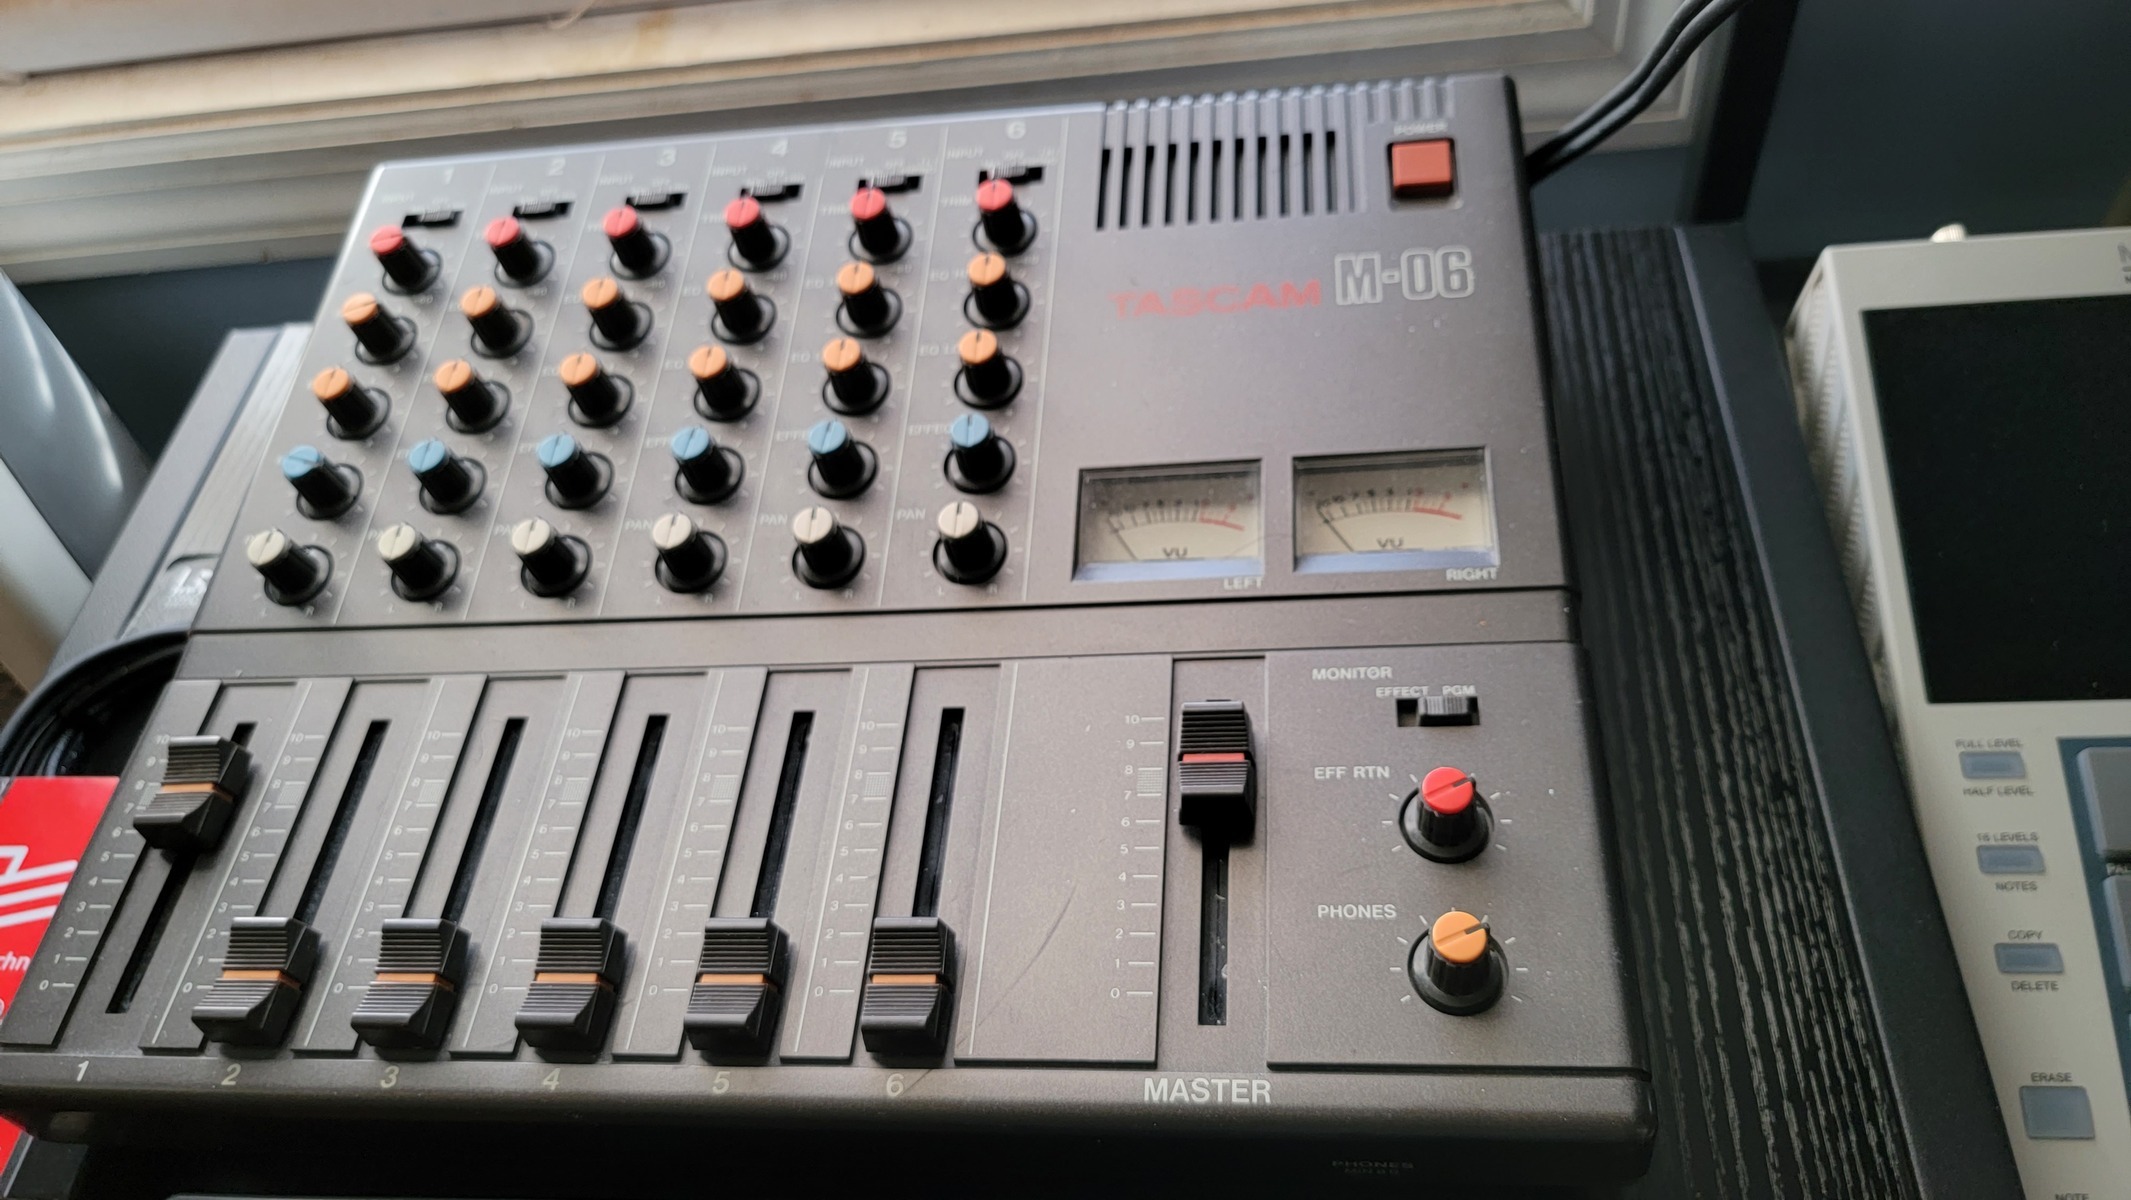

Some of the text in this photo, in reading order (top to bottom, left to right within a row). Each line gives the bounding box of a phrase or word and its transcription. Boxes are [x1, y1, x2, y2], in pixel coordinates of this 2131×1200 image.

[1007, 120, 1026, 140] 6
[1393, 121, 1447, 136] POWER
[888, 129, 907, 149] 5
[771, 138, 789, 157] 4
[656, 150, 676, 167] 3
[548, 157, 566, 176] 2
[1106, 244, 1475, 319] TASCAM M-06
[759, 514, 788, 526] PAN
[897, 508, 926, 521] PAN
[1376, 537, 1405, 549] VU
[1162, 546, 1189, 559] VU
[1446, 567, 1499, 582] RIGHT
[1223, 576, 1264, 591] LEFT
[1312, 666, 1393, 681] MONITOR
[1375, 686, 1429, 698] EFFECT
[1442, 685, 1476, 696] PGM
[1124, 714, 1140, 725] 10
[1126, 738, 1135, 749] 9
[1987, 738, 2023, 748] LEVEL
[1124, 764, 1134, 775] 8
[1314, 766, 1390, 780] EFF RTN
[1124, 790, 1132, 801] 7
[1963, 786, 2034, 796] HALF LEVEL
[690, 821, 699, 833] 6
[844, 819, 854, 830] 6
[1121, 816, 1131, 828] 6
[112, 826, 123, 838] 6
[251, 825, 262, 837] 6
[394, 825, 404, 836] 6
[539, 823, 548, 834] 6
[1993, 832, 2039, 842] LEVELS
[384, 849, 394, 861] 5
[530, 848, 540, 860] 5
[683, 847, 692, 859] 5
[839, 845, 849, 857] 5
[1119, 843, 1129, 855] 5
[101, 850, 111, 862] 5
[240, 850, 250, 862] 5
[88, 876, 98, 887] 4
[229, 875, 240, 887] 4
[375, 875, 384, 886] 4
[522, 874, 532, 886] 4
[676, 874, 686, 885] 4
[834, 872, 845, 884] 4
[1117, 871, 1127, 882] 4
[1995, 881, 2038, 891] NOTES
[76, 901, 86, 912] 3
[218, 901, 229, 913] 3
[364, 901, 374, 912] 3
[514, 901, 524, 912] 3
[670, 901, 679, 912] 3
[829, 900, 839, 912] 3
[1116, 899, 1125, 911] 3
[1317, 904, 1397, 919] PHONES
[64, 926, 75, 938] 2
[207, 927, 217, 939] 2
[354, 927, 364, 939] 2
[506, 928, 516, 939] 2
[662, 928, 673, 939] 2
[825, 928, 835, 940] 2
[1115, 927, 1124, 939] 2
[2008, 930, 2043, 940] COPY
[1114, 957, 1121, 969] 1
[39, 980, 50, 991] 0
[183, 981, 193, 993] 0
[333, 982, 344, 994] 0
[489, 983, 499, 995] 0
[648, 984, 658, 996] 0
[814, 985, 824, 998] 0
[2011, 981, 2059, 992] DELETE
[1110, 987, 1121, 999] 0
[75, 1060, 90, 1081] 1
[221, 1064, 242, 1086] 2
[380, 1066, 399, 1088] 3
[542, 1068, 562, 1091] 4
[712, 1071, 731, 1095] 5
[2030, 1072, 2073, 1082] ERASE
[886, 1073, 905, 1098] 6
[1143, 1077, 1271, 1104] MASTER
